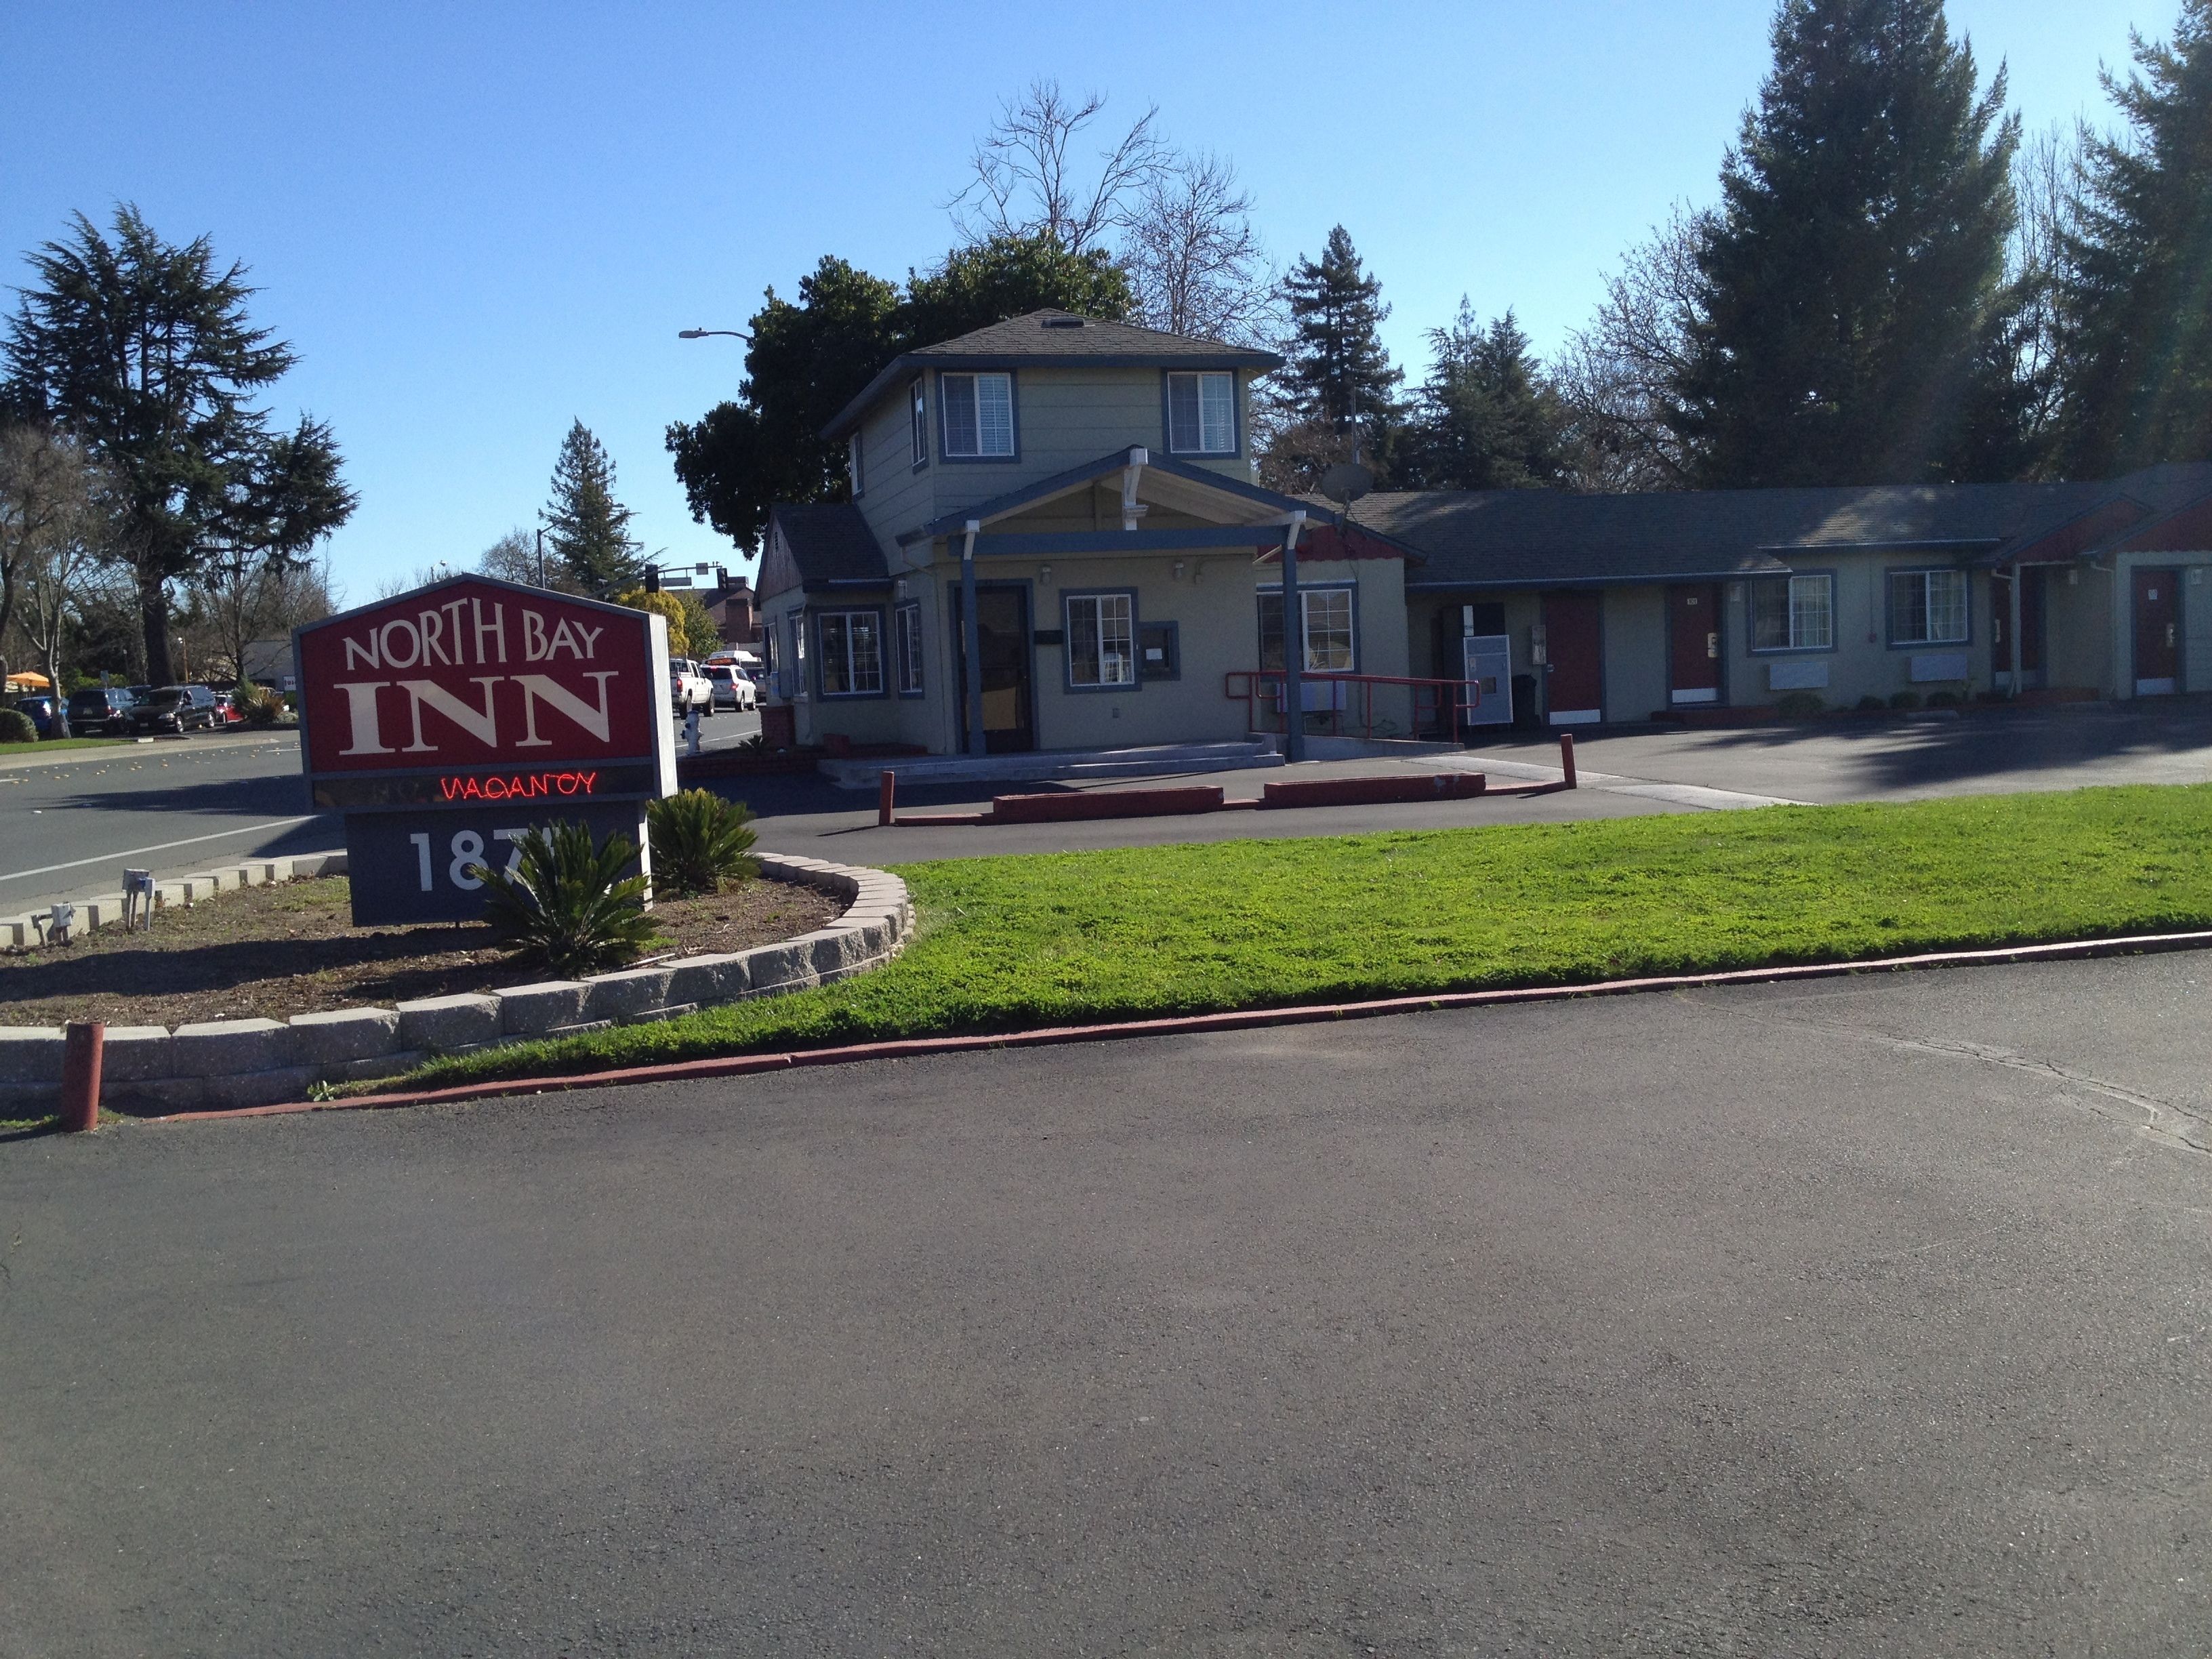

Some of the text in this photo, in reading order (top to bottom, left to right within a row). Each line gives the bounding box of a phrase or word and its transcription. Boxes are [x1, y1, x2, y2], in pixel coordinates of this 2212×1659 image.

[342, 597, 604, 670] NORTH BAY
[333, 671, 619, 756] INN
[441, 771, 596, 800] VACANCY
[410, 827, 560, 891] 187
